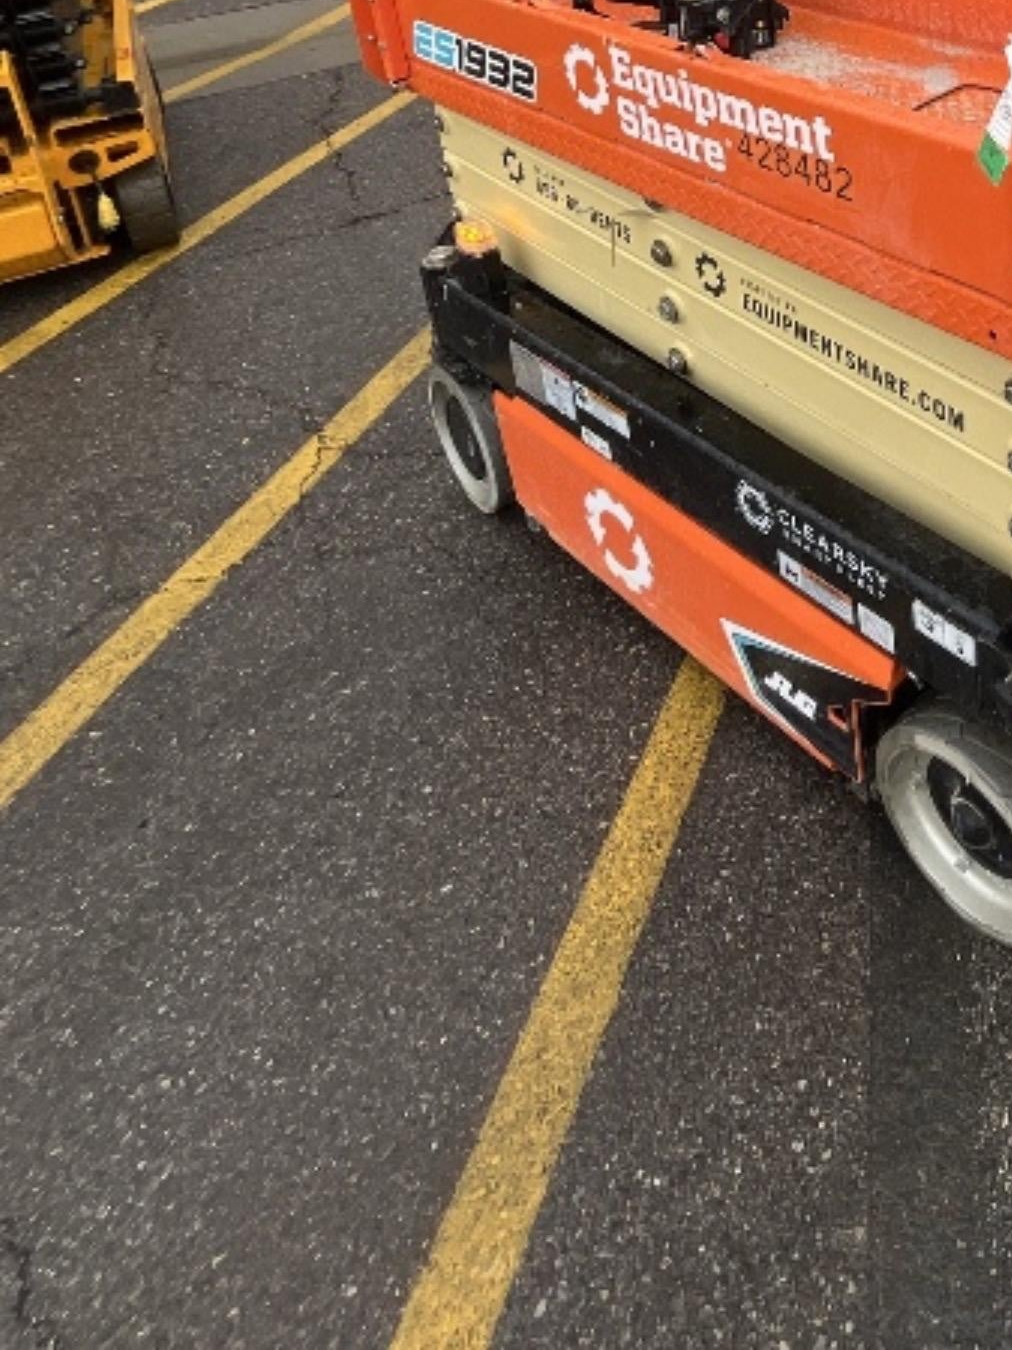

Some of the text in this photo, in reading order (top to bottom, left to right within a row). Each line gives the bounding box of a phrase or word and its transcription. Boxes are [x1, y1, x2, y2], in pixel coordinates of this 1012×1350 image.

[415, 22, 536, 101] ES1932
[608, 41, 835, 162] Equipment
[616, 96, 727, 172] Share
[736, 132, 854, 201] 428482
[742, 292, 965, 432] EQUIPMENTSHARE.COM
